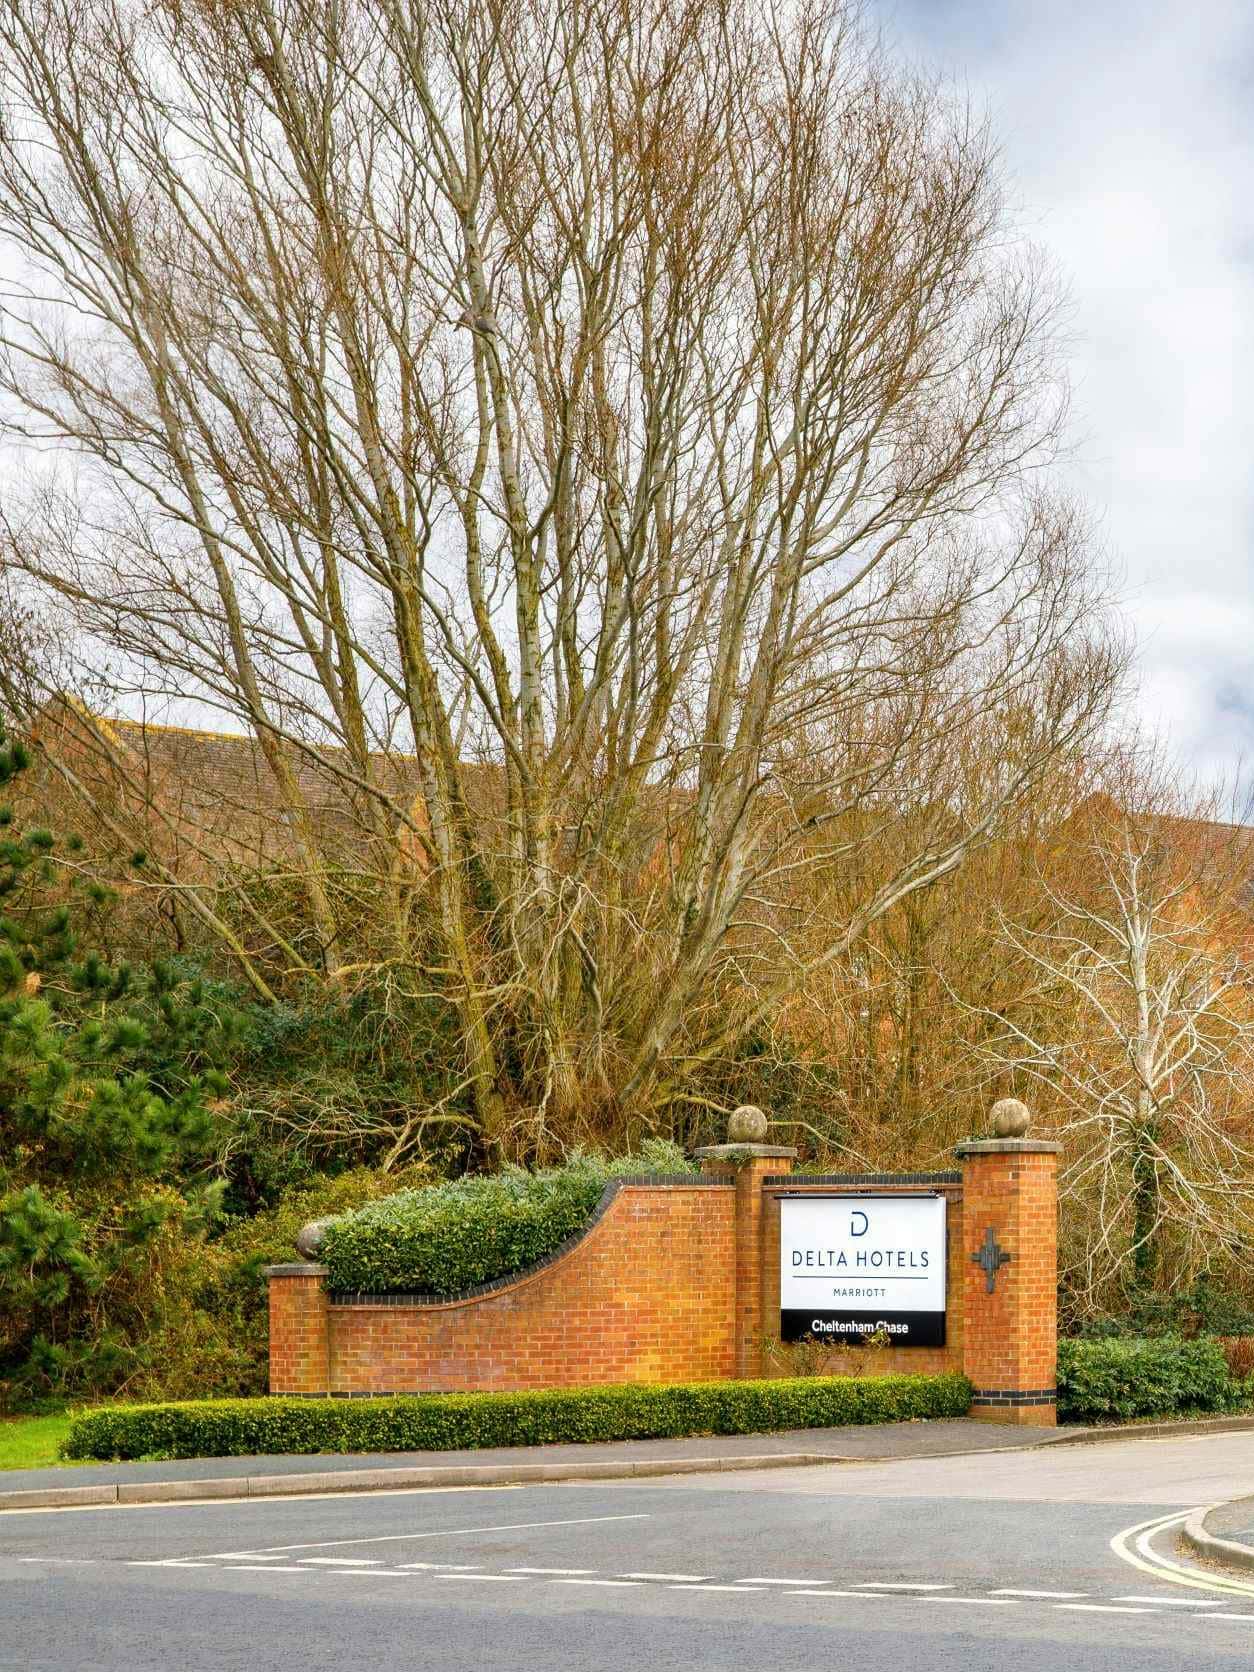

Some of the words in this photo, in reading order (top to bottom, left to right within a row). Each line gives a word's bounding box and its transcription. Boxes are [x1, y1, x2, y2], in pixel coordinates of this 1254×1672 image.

[851, 1211, 869, 1237] D
[792, 1250, 848, 1267] DELTA
[856, 1250, 929, 1268] HOTELS
[833, 1288, 886, 1297] MARRIOTT
[811, 1319, 874, 1334] Cheltenham
[875, 1320, 909, 1334] Chase
